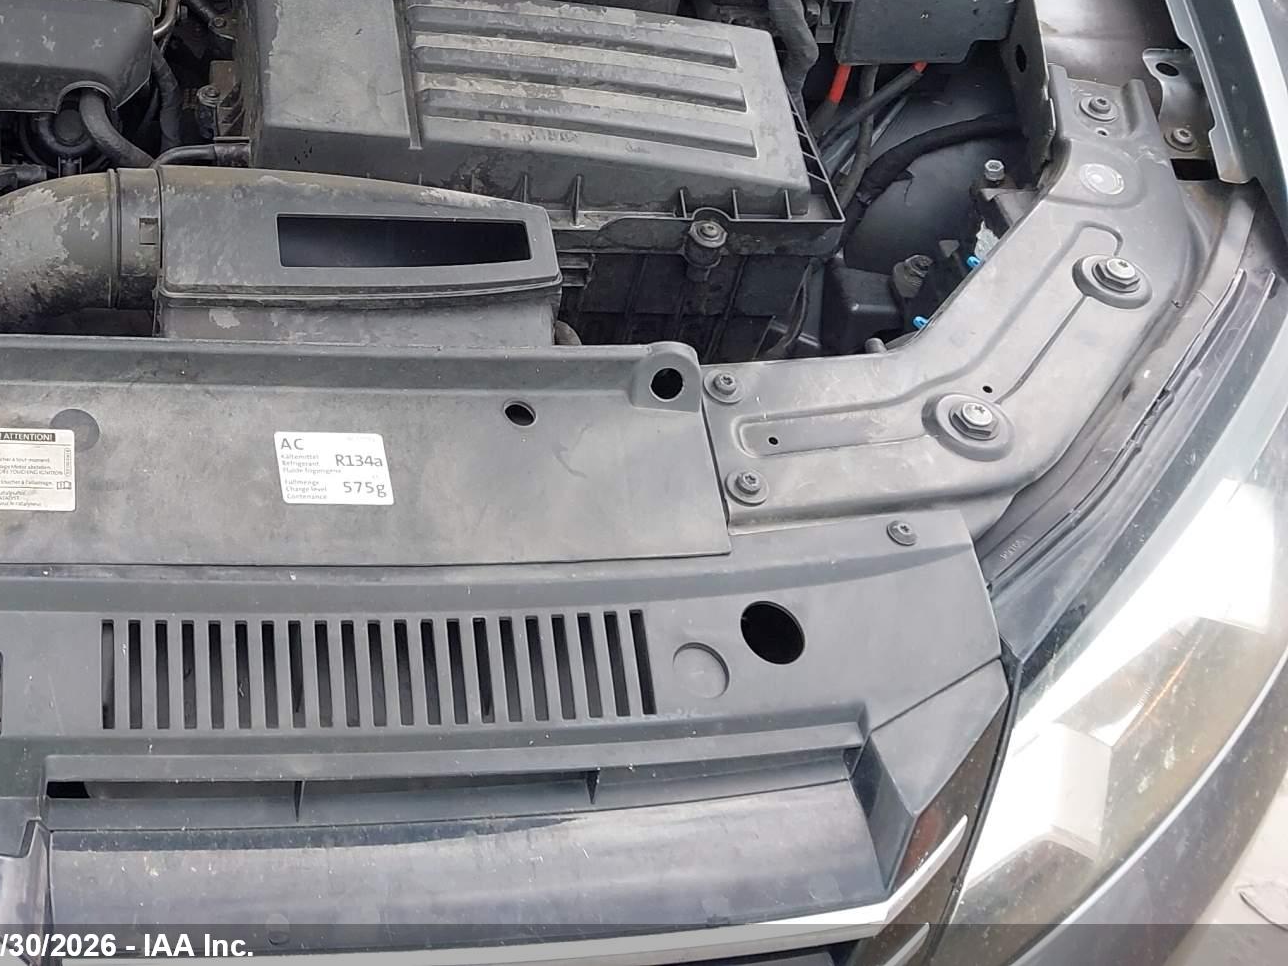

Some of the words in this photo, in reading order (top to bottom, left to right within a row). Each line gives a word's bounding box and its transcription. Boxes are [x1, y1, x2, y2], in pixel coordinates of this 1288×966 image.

[3, 433, 53, 441] ATTENTION!
[281, 438, 304, 450] AC
[335, 454, 383, 467] R134a
